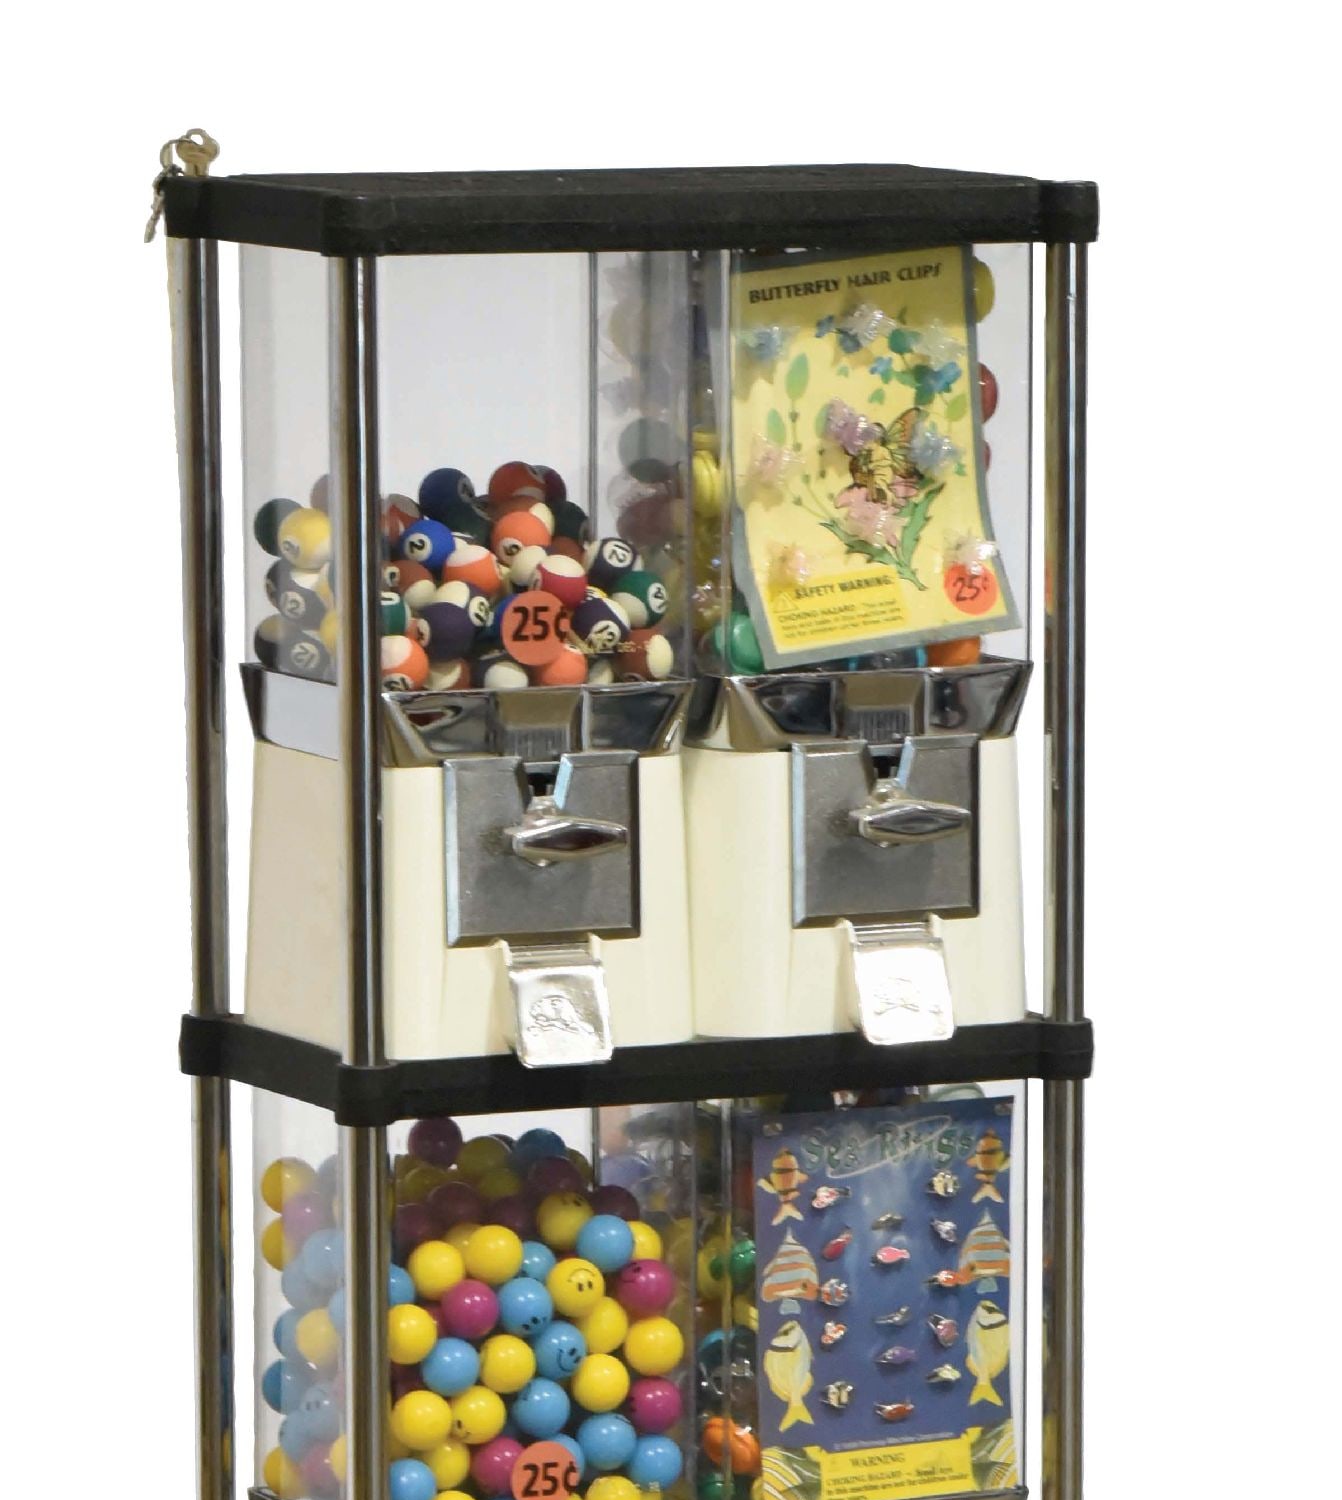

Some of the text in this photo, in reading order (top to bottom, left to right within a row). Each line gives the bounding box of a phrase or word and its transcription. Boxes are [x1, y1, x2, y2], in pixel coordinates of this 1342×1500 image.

[749, 263, 942, 304] BUTTERFLY HAIR CLIPS
[408, 538, 426, 554] 2
[609, 543, 630, 563] 12
[795, 584, 835, 600] SAFETY
[850, 1452, 906, 1467] WARNING
[522, 1461, 577, 1498] 25¢
